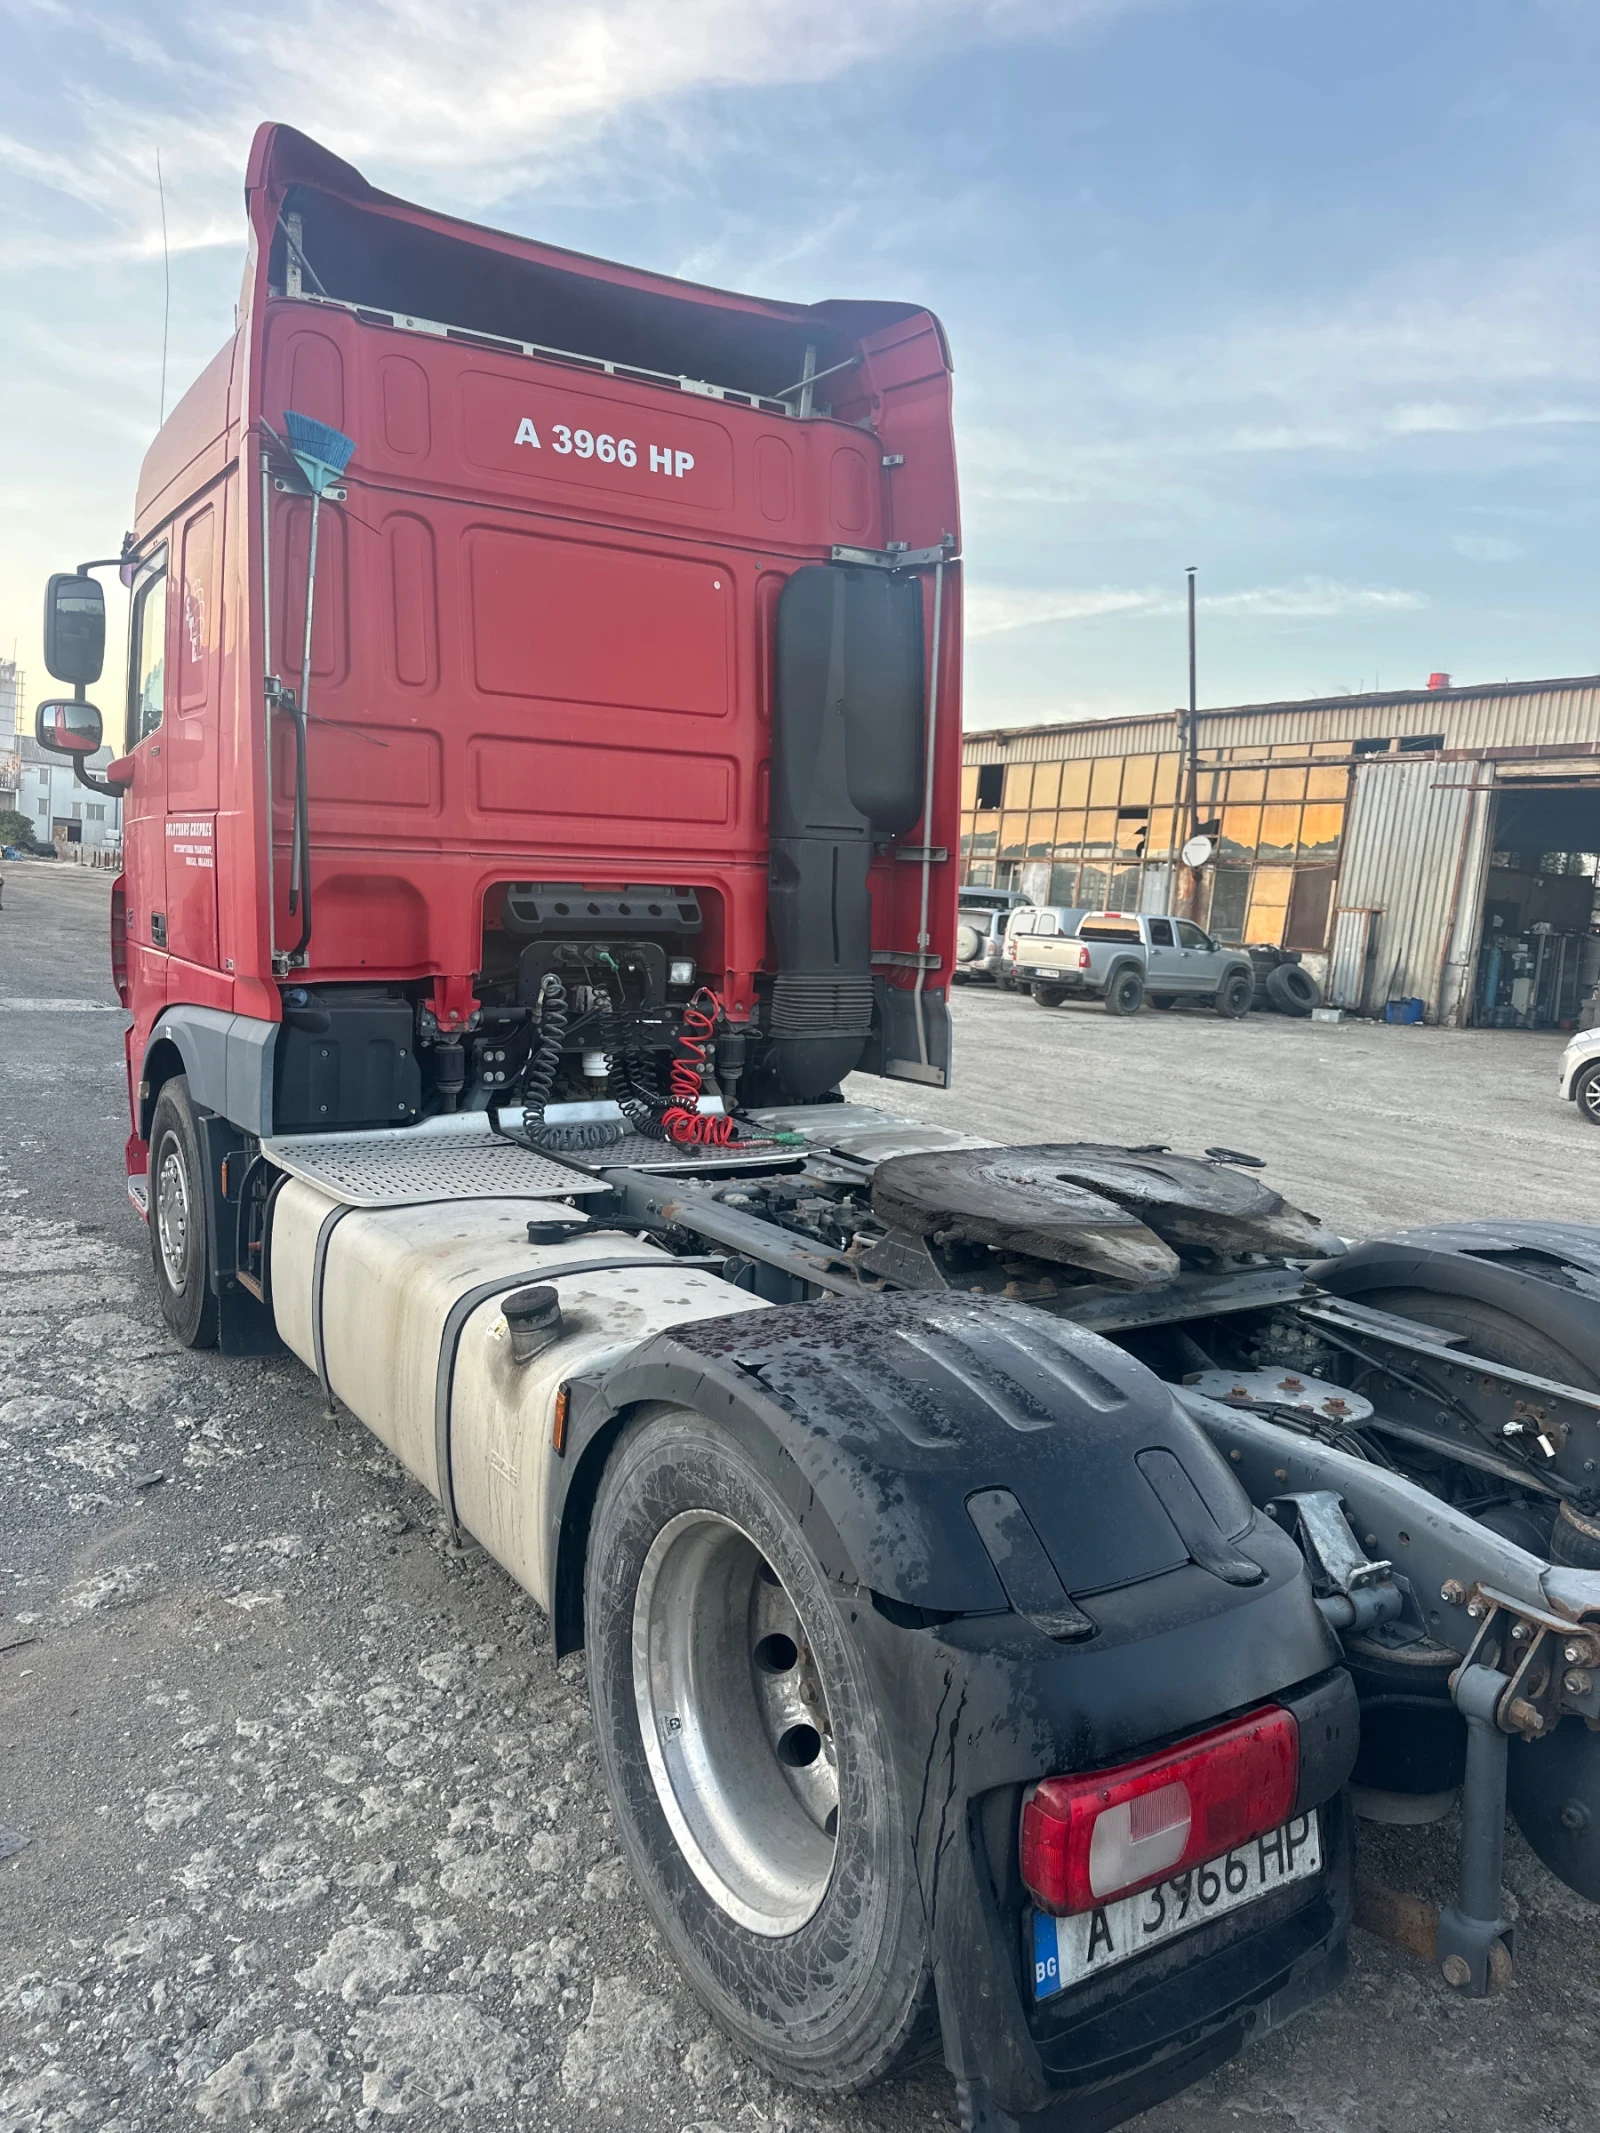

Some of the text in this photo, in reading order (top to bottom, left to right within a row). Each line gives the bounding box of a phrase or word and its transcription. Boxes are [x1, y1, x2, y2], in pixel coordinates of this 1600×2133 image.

[513, 417, 695, 478] A 3966 HP
[1035, 1812, 1309, 1983] BG A 3966 HP
